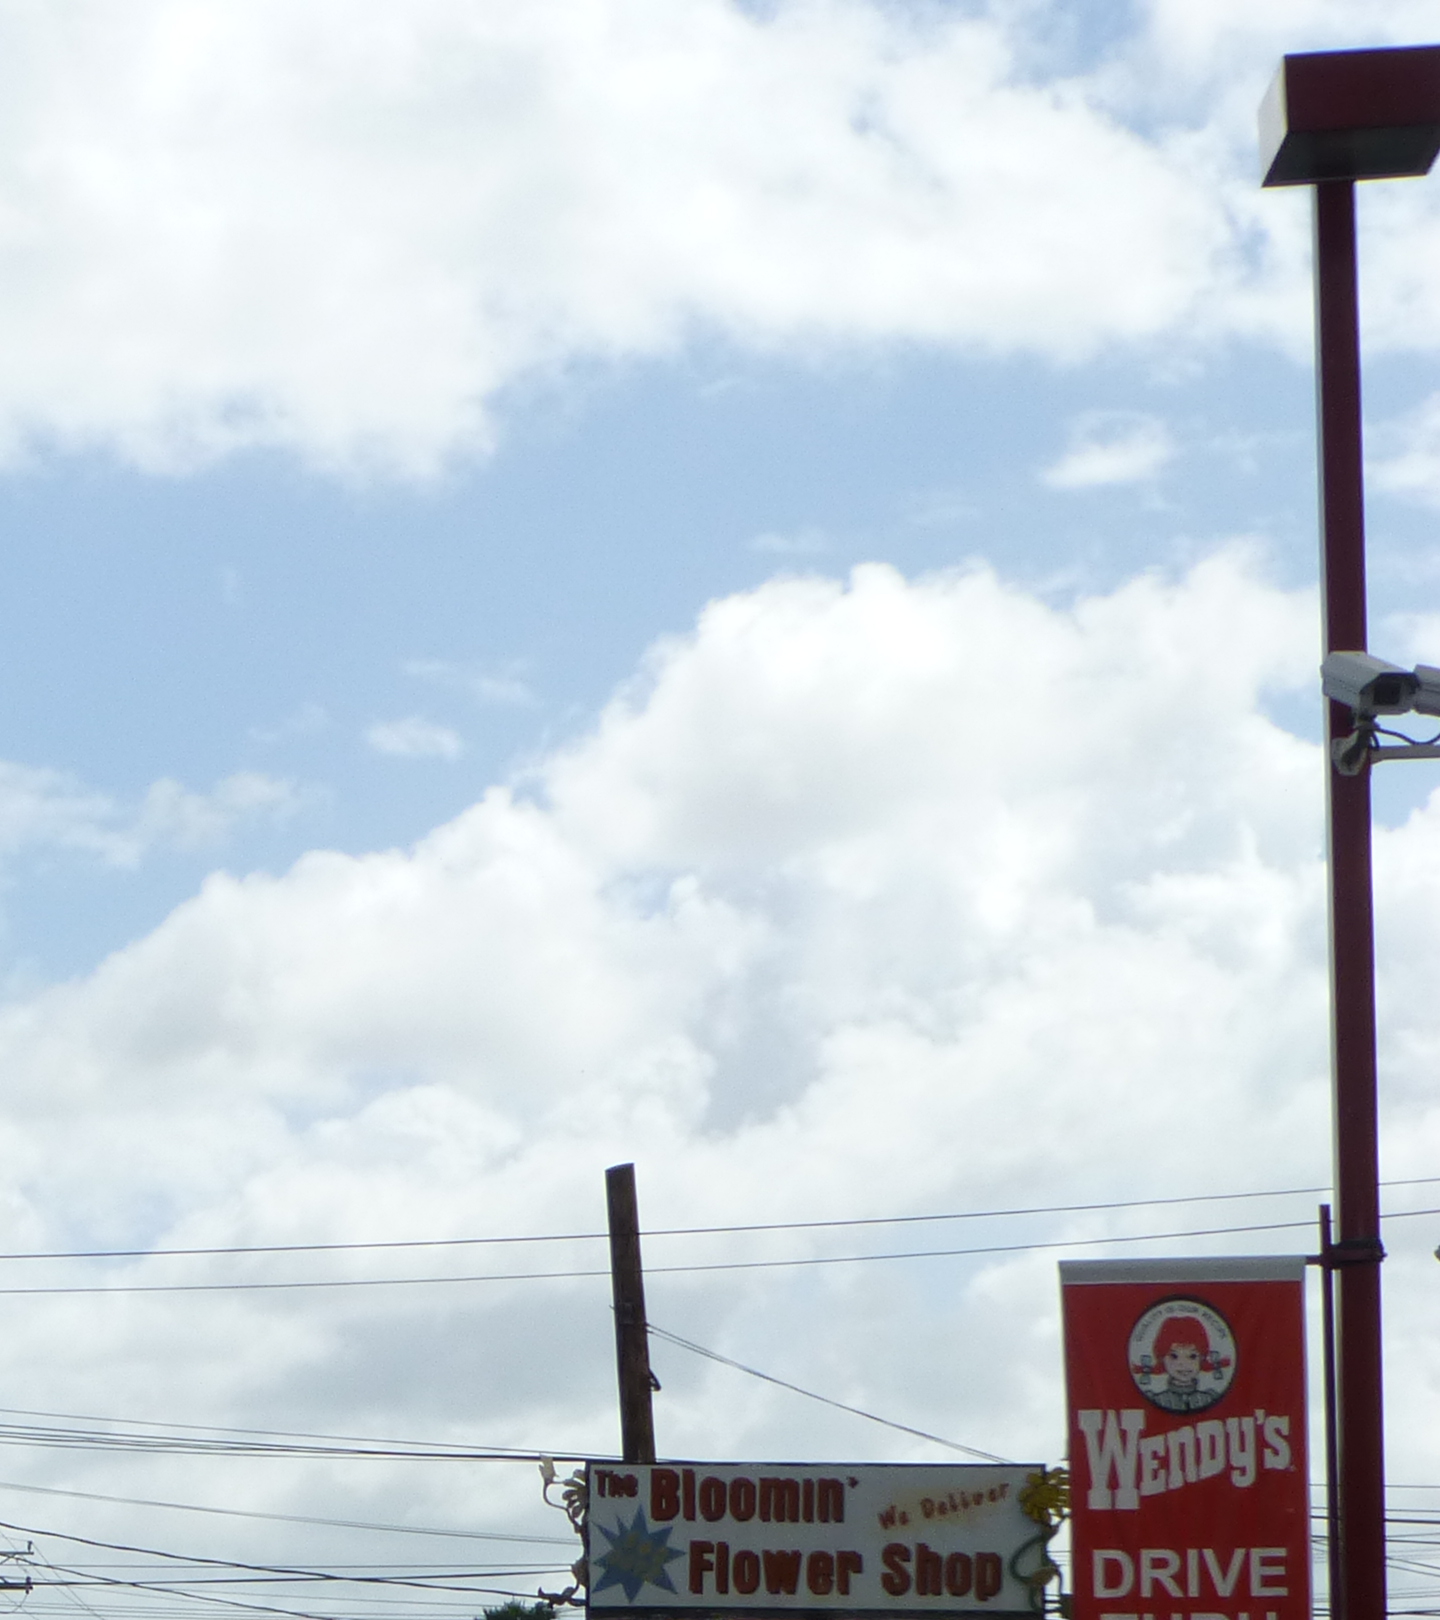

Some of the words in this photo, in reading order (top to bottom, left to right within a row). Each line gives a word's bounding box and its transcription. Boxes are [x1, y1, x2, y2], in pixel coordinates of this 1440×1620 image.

[595, 1469, 639, 1498] The
[650, 1467, 858, 1524] Bloomin'
[688, 1540, 864, 1597] Flower
[881, 1542, 1005, 1602] Shop
[1091, 1547, 1290, 1600] DRIVE
